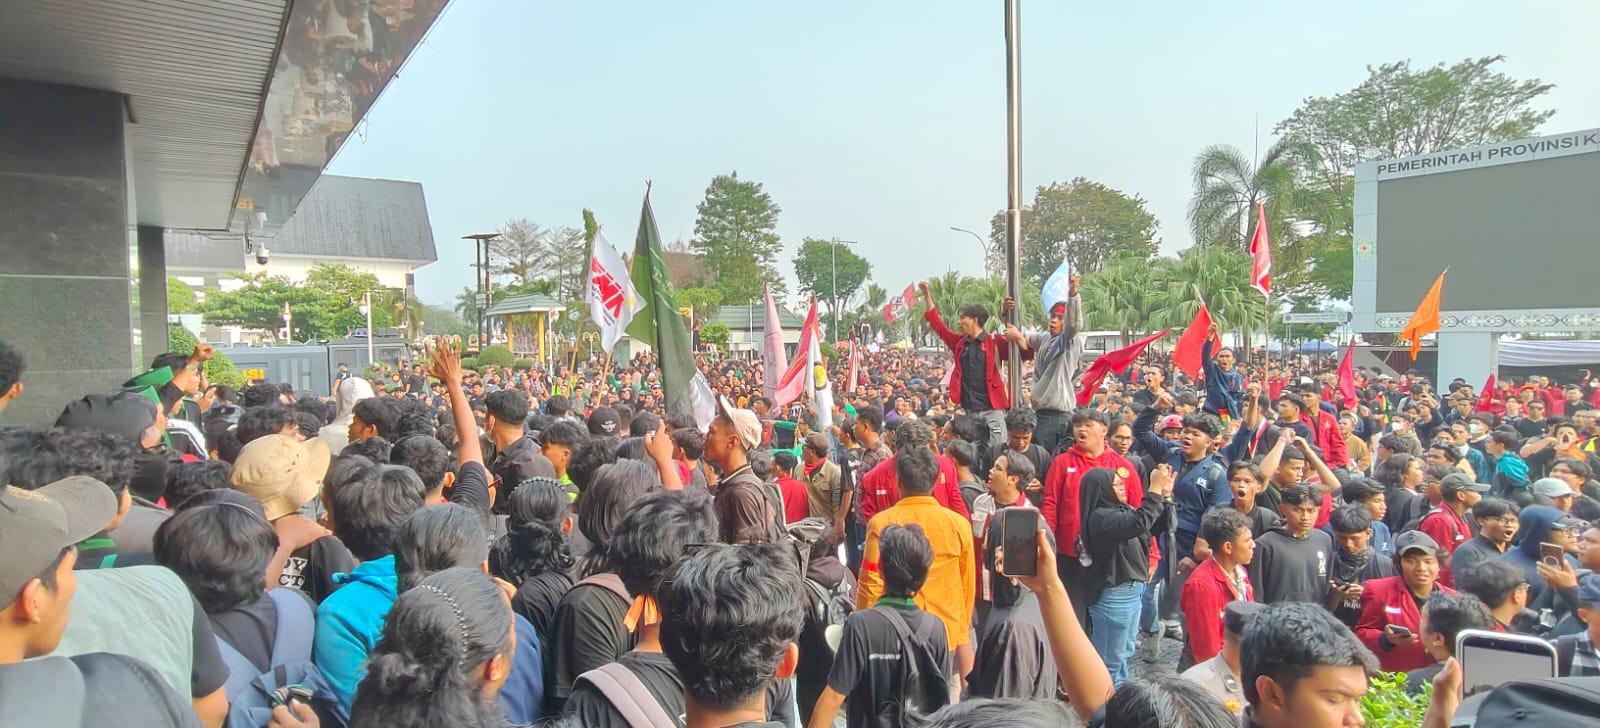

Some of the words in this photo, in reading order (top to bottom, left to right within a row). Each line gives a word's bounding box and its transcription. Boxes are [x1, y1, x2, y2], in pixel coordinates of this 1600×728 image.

[1377, 150, 1482, 174] PEMERINTAH
[1488, 136, 1579, 159] PROVINSI
[1584, 133, 1600, 146] K
